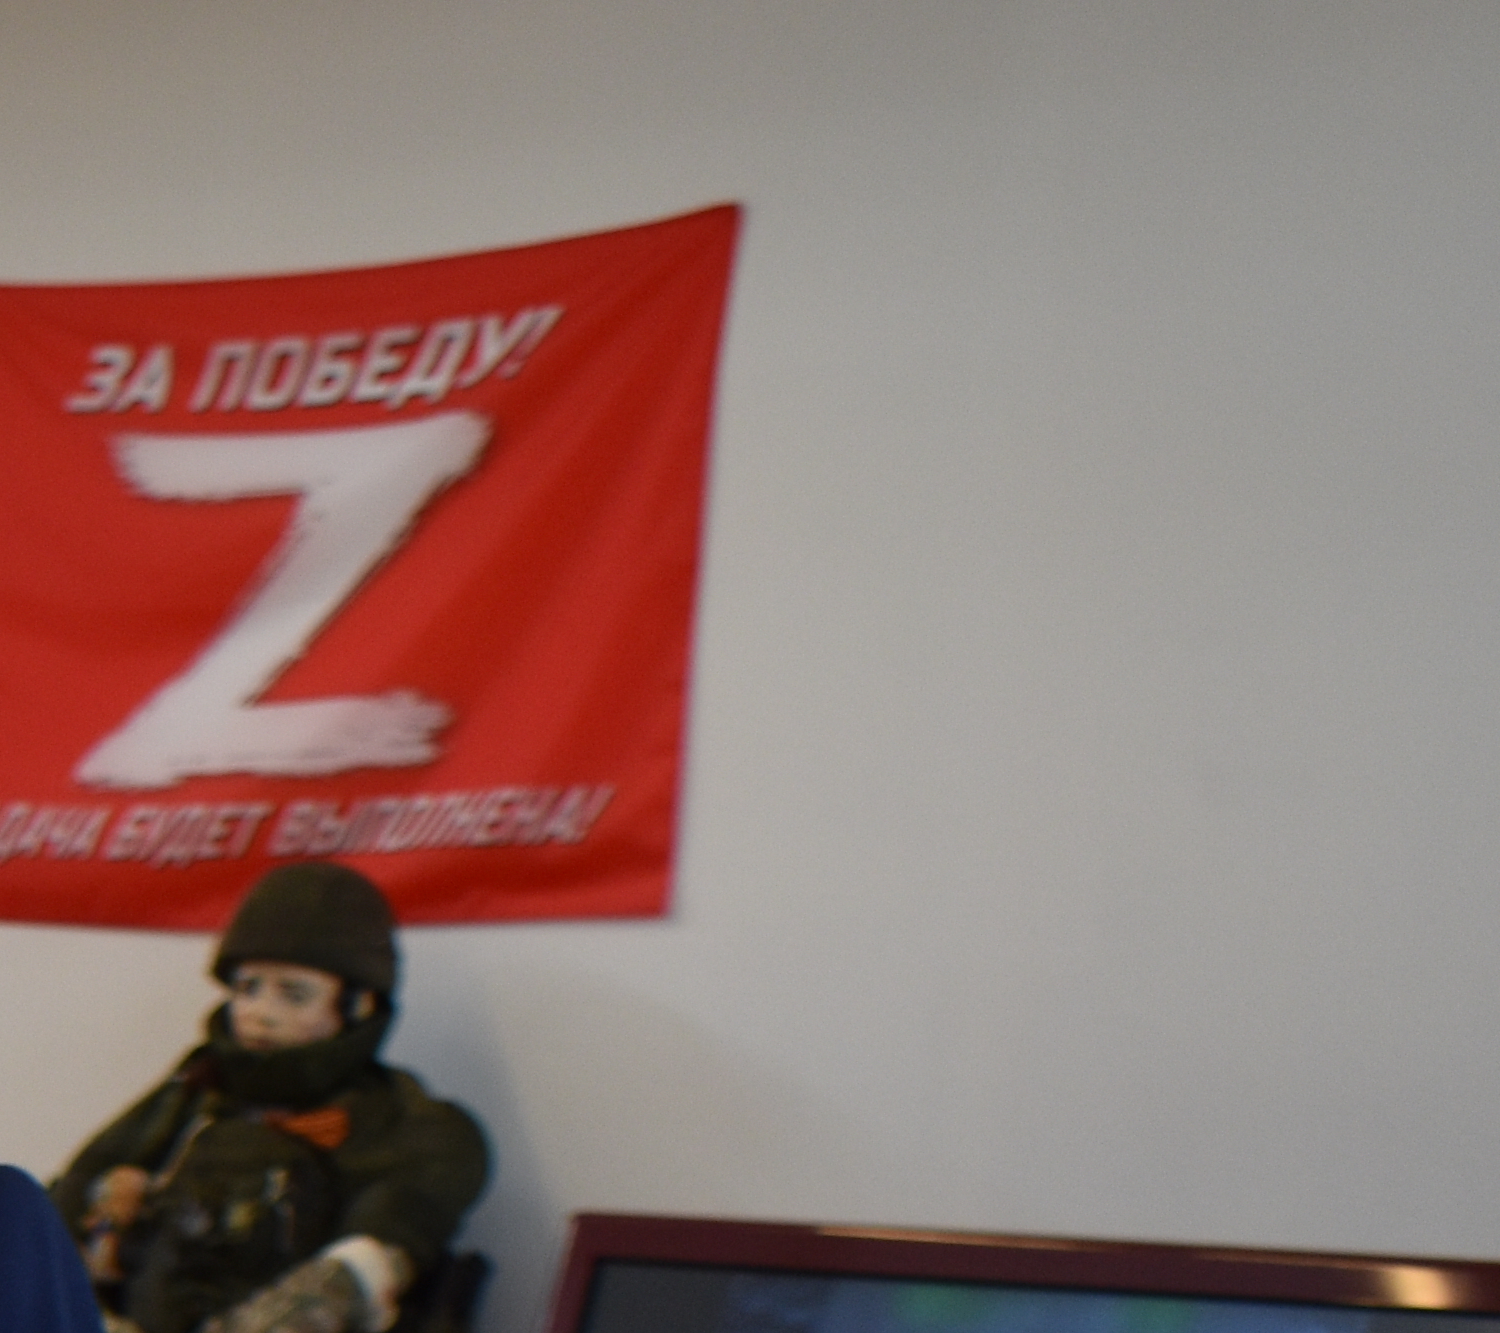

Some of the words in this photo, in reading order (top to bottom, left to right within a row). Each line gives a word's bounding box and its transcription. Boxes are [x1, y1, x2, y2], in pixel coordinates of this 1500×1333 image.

[64, 343, 170, 412] ЗА
[188, 306, 564, 413] ПОБЕДУ!
[72, 408, 495, 792] Z
[105, 800, 272, 870] БУДЕТ
[269, 785, 617, 860] ВЫПОЛНЕНА!
